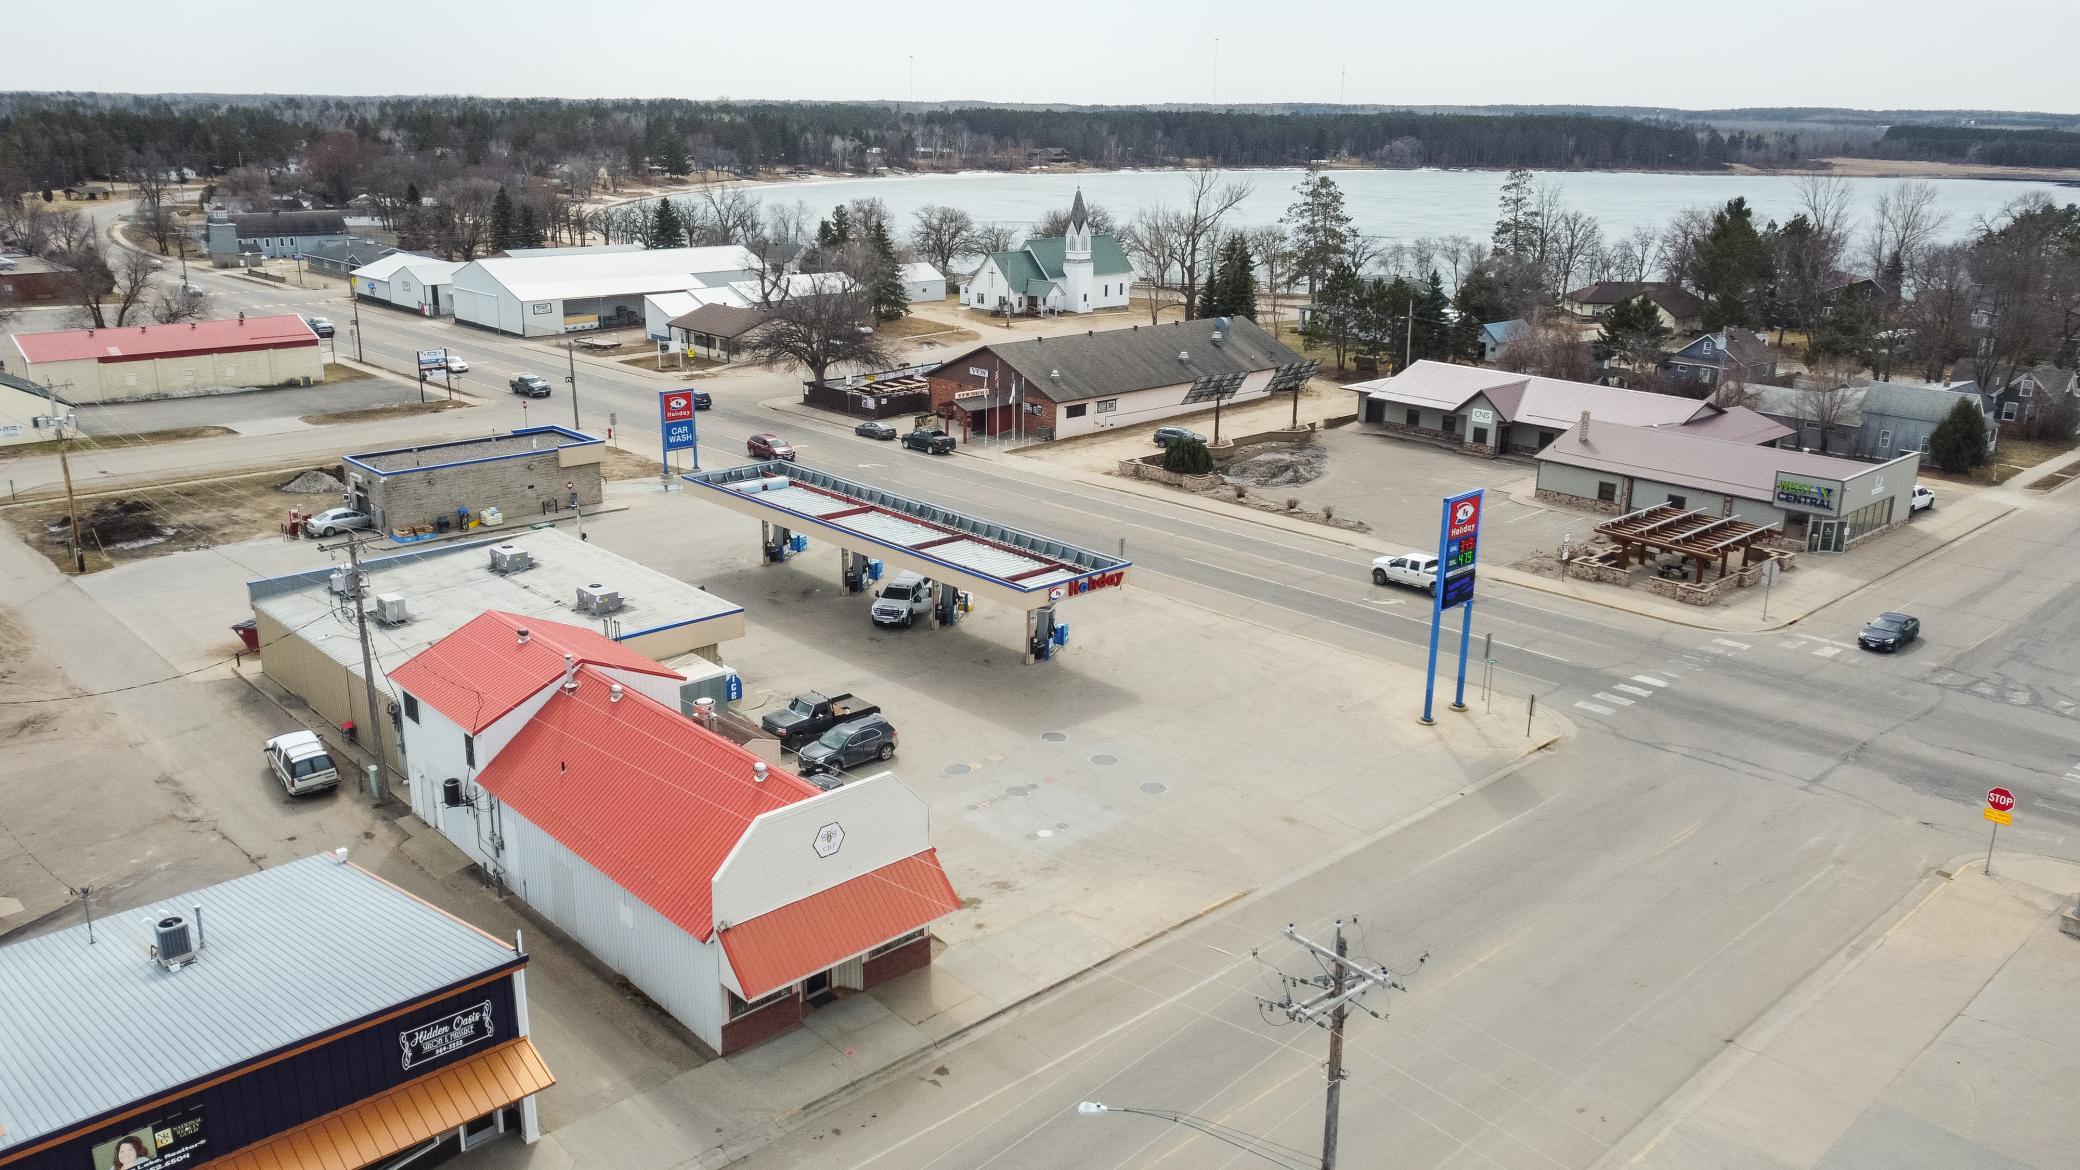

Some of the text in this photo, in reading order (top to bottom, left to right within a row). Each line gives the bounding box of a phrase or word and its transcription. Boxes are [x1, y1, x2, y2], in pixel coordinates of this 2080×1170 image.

[667, 410, 690, 418] Holiday
[1475, 411, 1490, 419] CNS
[671, 426, 688, 435] CAR
[669, 434, 692, 443] WASH
[1776, 480, 1817, 497] WEST
[1777, 491, 1833, 510] CENTRAL
[1451, 523, 1476, 537] Holiday
[1068, 572, 1124, 596] Holiday
[1988, 792, 2013, 806] STOP
[410, 1012, 481, 1047] Hidden Oasis
[137, 1158, 163, 1170] Lake,
